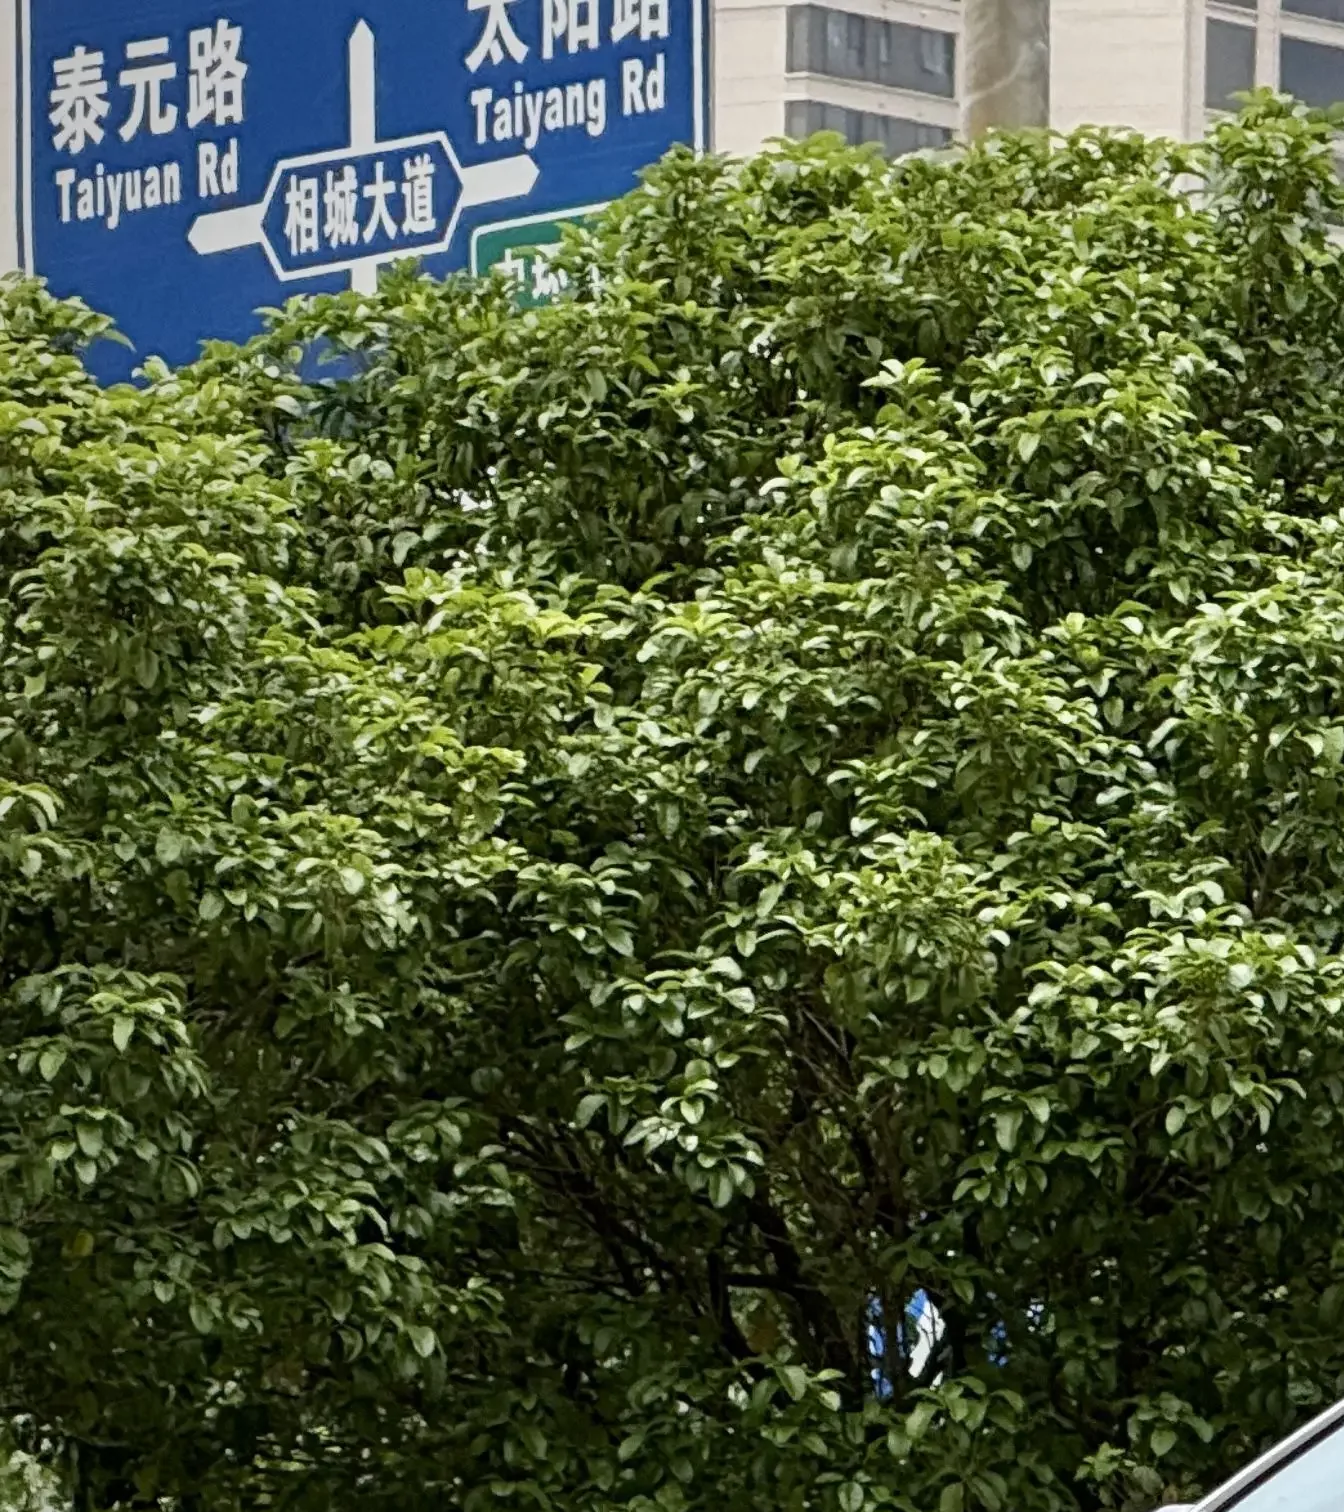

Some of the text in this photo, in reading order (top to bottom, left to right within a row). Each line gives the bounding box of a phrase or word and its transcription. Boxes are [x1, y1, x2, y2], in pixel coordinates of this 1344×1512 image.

[48, 18, 248, 155] 泰元路
[471, 53, 667, 150] Taiyang Rd
[55, 138, 238, 229] Taiyuan Rd
[283, 153, 437, 256] 相城大道
